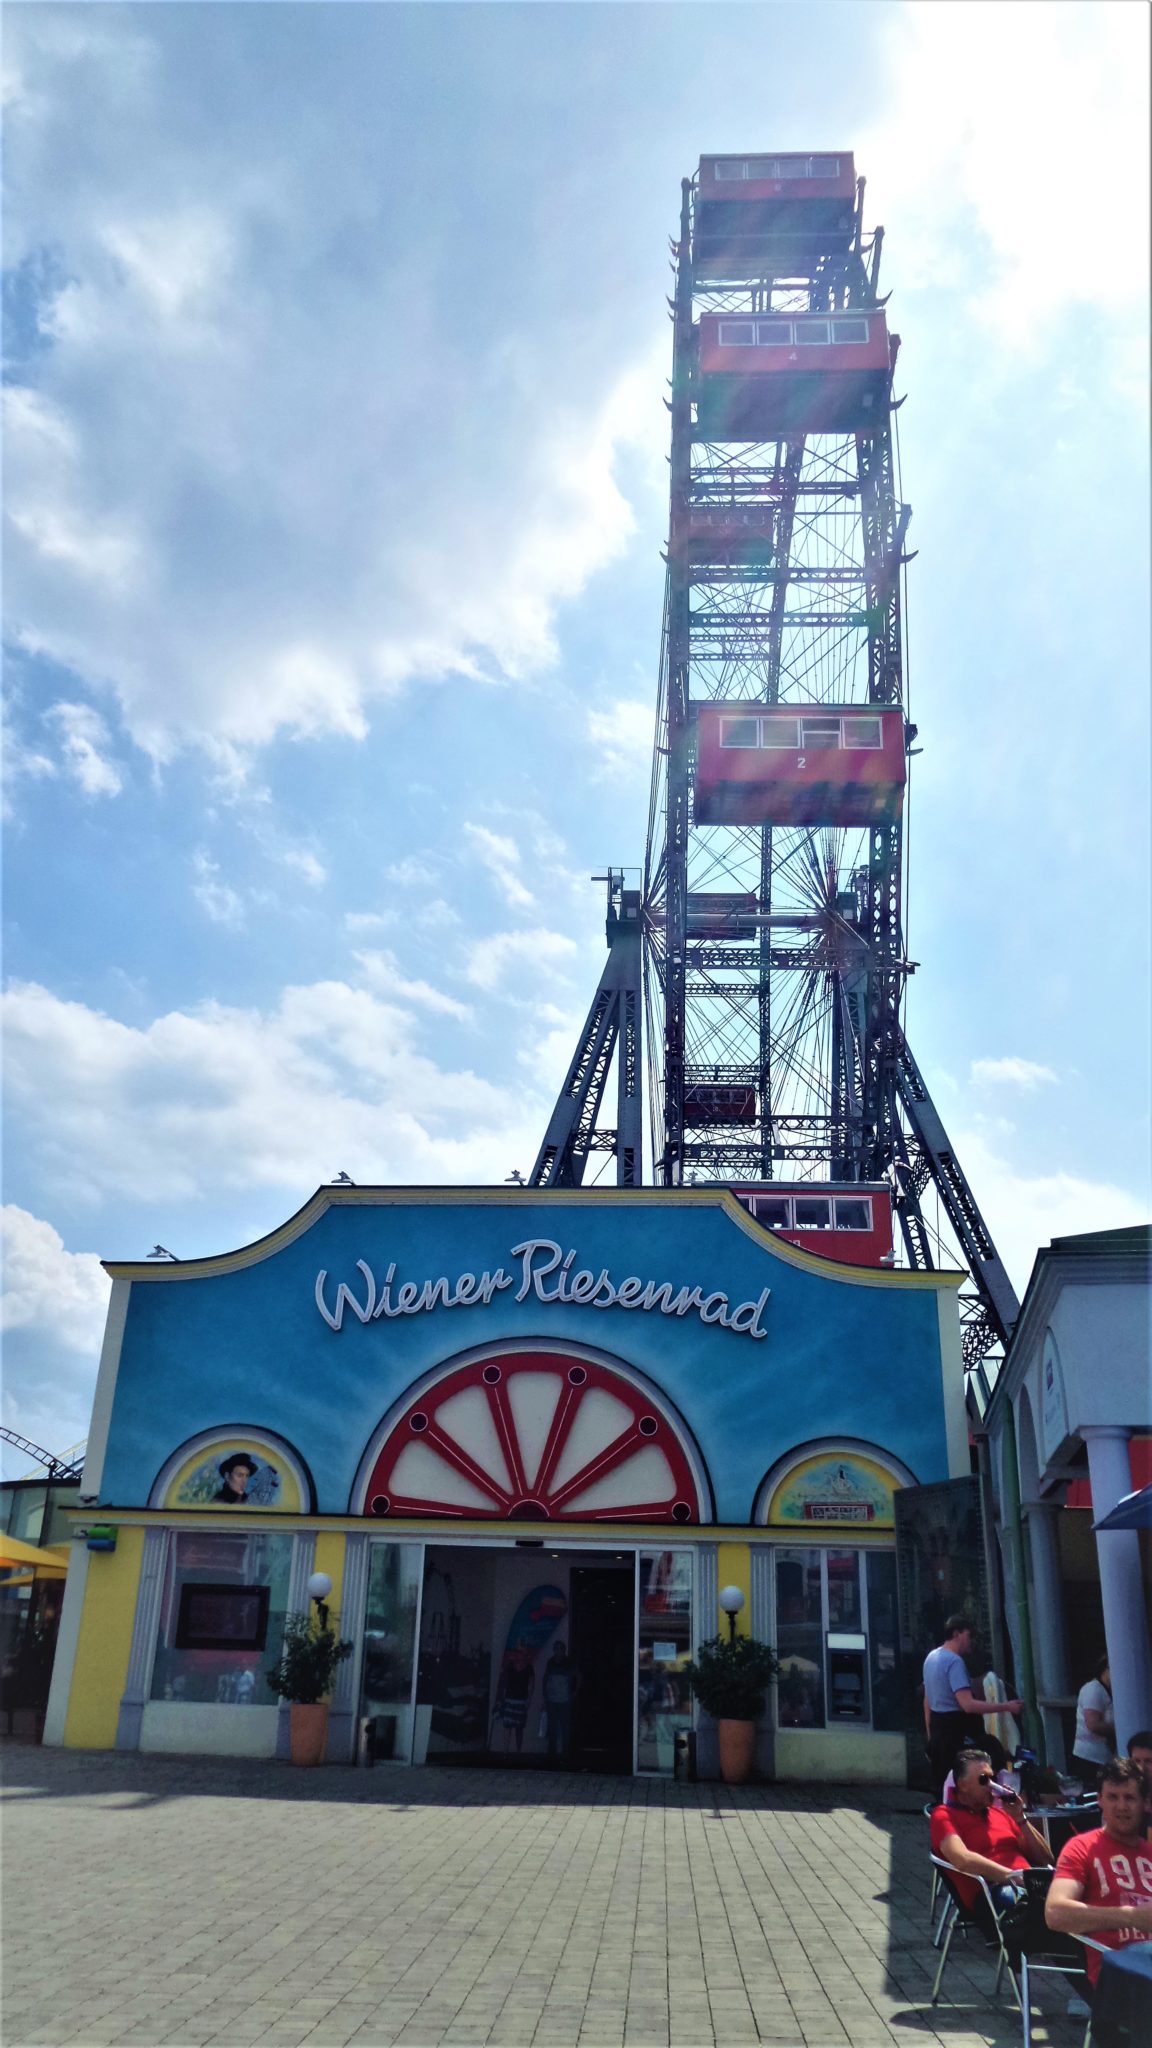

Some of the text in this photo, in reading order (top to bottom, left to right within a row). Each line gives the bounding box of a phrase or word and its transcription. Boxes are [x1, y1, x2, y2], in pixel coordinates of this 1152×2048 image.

[797, 757, 806, 769] 2
[314, 1238, 771, 1338] Wiener Riesenrad
